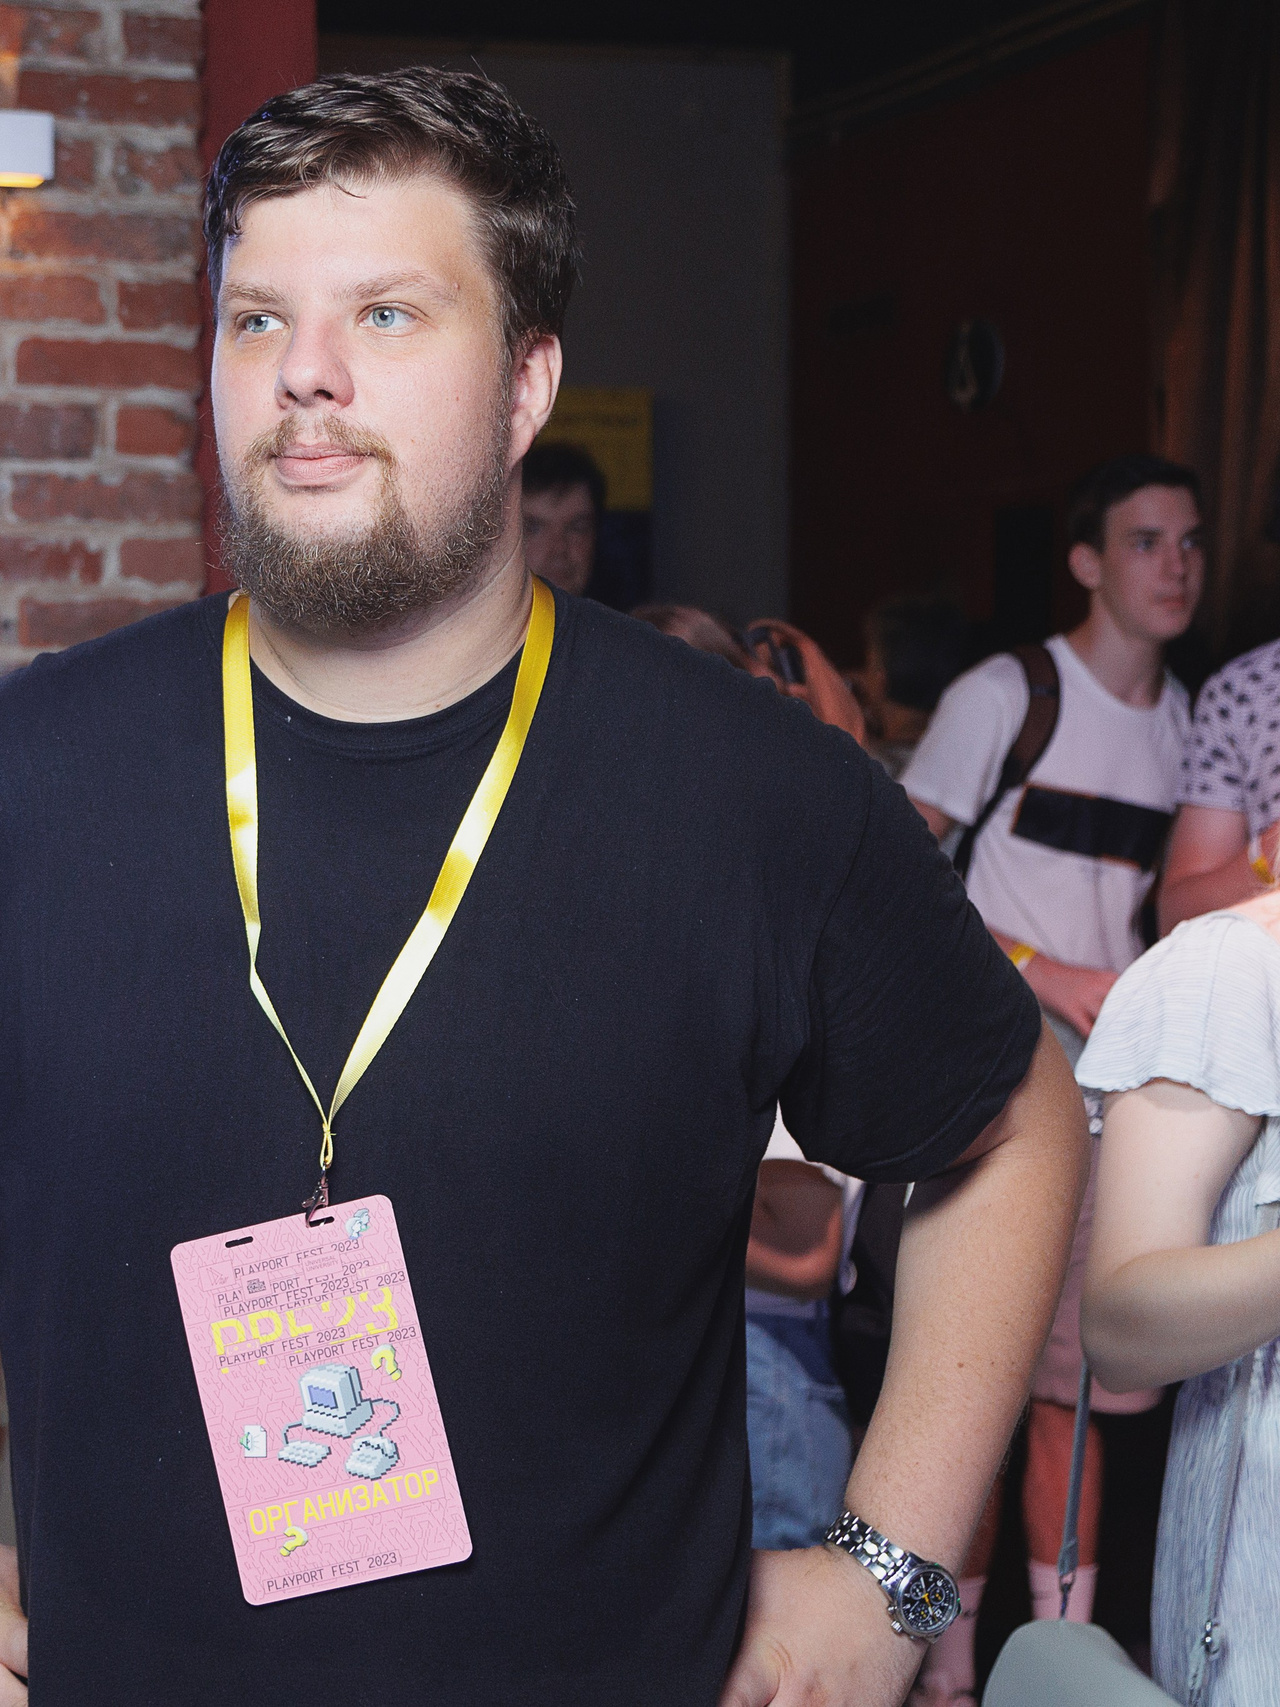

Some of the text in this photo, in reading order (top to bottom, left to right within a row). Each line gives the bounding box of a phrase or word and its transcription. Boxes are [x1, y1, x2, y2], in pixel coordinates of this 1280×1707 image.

[234, 1256, 289, 1278] PLAYPORT
[376, 1271, 406, 1287] 2023
[224, 1294, 279, 1317] PLAYPORT
[286, 1286, 314, 1301] FEST
[321, 1277, 349, 1293] 2023
[219, 1327, 346, 1366] PLAYPORT FEST 2023
[289, 1327, 417, 1366] PLAYPORT FEST 2023
[248, 1468, 439, 1536] ОРГАНИЗАТОР
[266, 1552, 397, 1591] PLAYPORT FEST 2023
